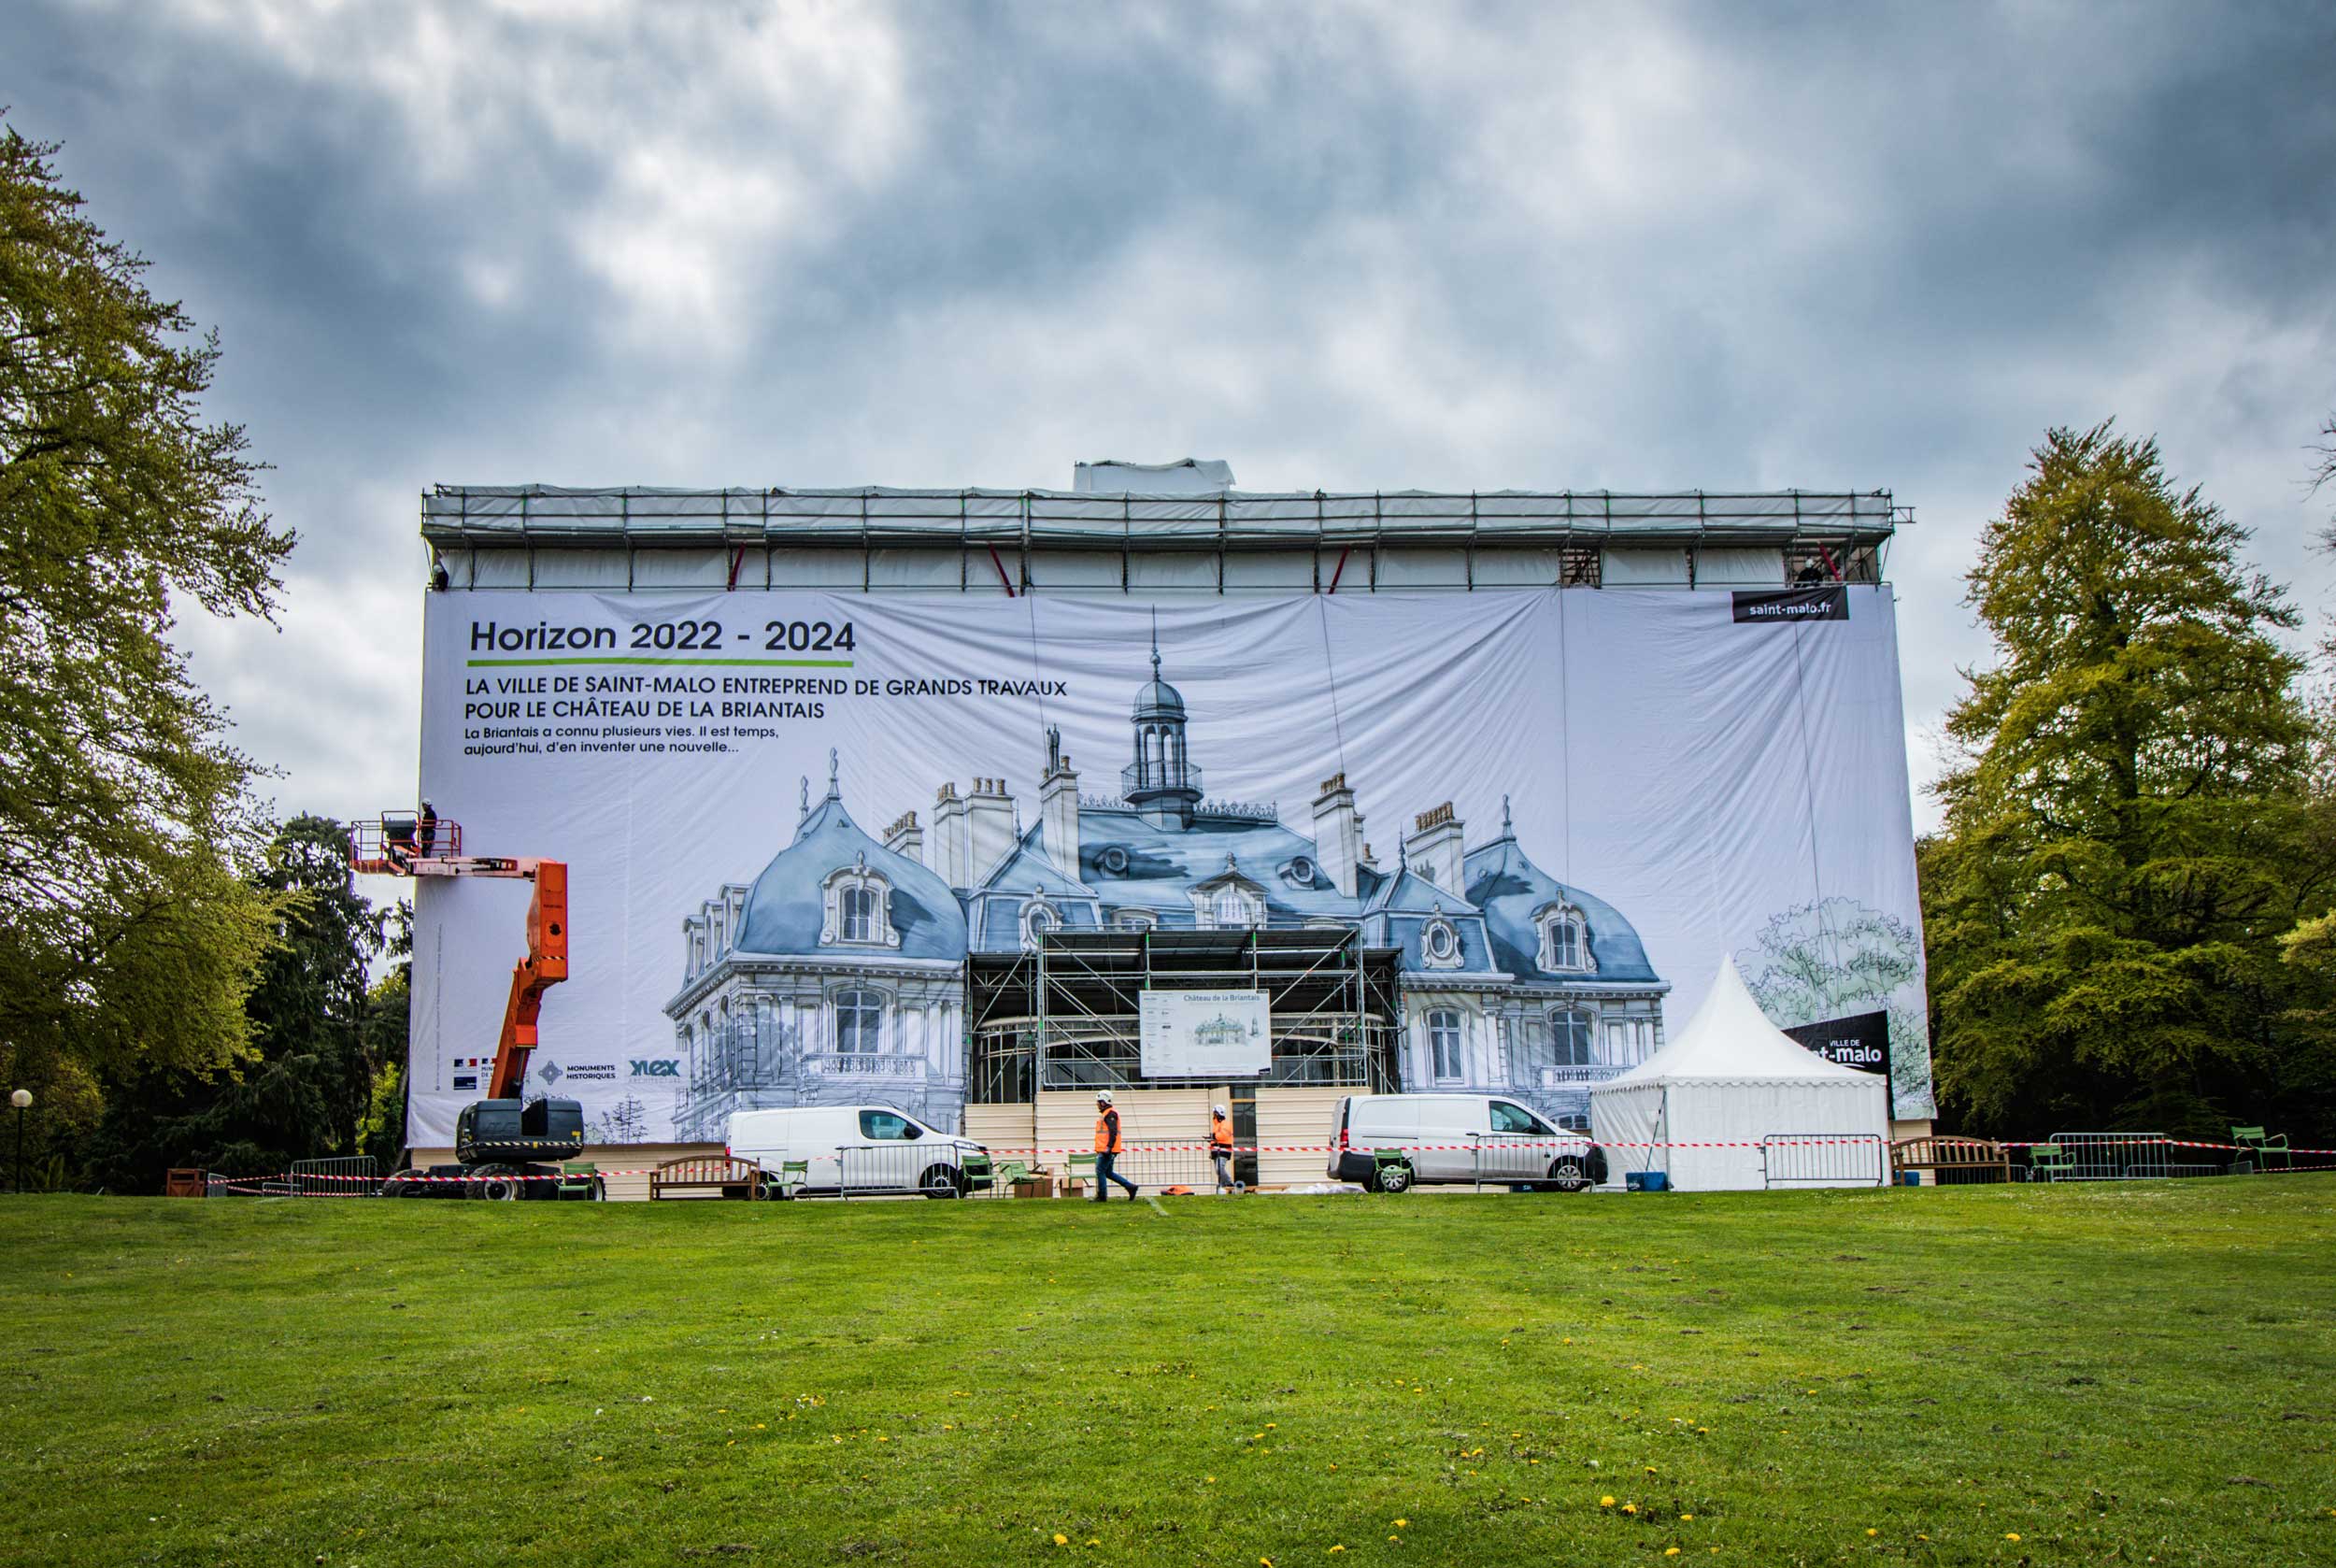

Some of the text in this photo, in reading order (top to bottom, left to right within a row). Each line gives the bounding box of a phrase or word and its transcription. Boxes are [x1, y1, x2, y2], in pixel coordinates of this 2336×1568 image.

[1748, 601, 1832, 616] saint-malo.fr
[469, 620, 617, 651] Horizon
[630, 620, 722, 650] 2022
[764, 620, 856, 652] 2024
[466, 677, 1067, 696] LA VILLE DE SAINT-MALO ENTREPREND DE GRANDS TRAVAUX
[465, 697, 824, 719] POUR LE CHÂTEAU DE LA BRIANTAIS
[464, 725, 779, 740] La Briantais a connu plusieurs vies. Il est temps,
[463, 741, 740, 757] aujourd'hui, d'en inventer une nouvelle...
[1230, 993, 1261, 1002] Briantais
[1812, 1046, 1883, 1062] t-malo
[566, 1072, 616, 1080] HISTORIQUES
